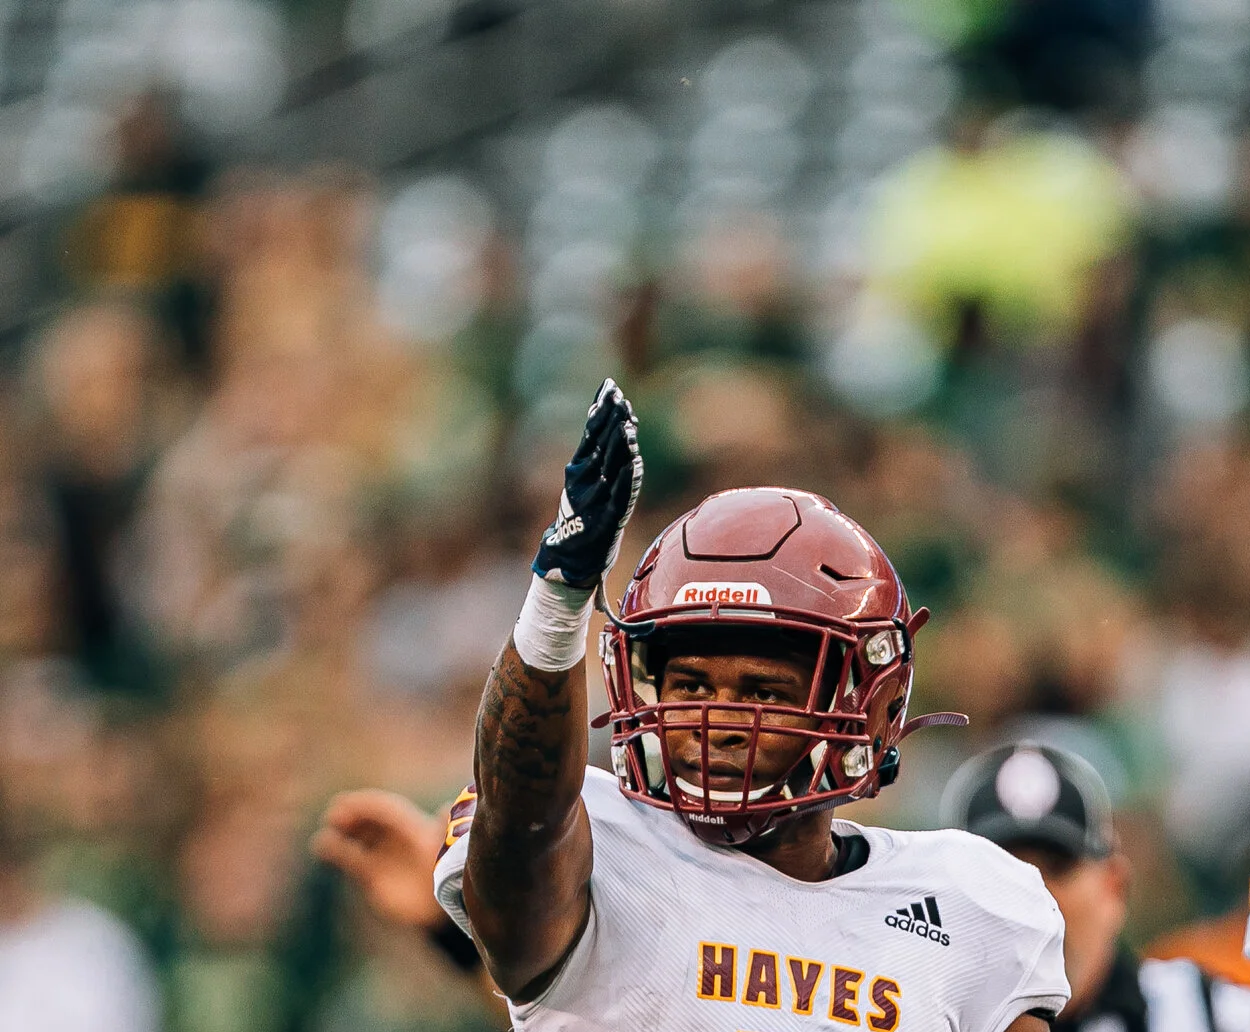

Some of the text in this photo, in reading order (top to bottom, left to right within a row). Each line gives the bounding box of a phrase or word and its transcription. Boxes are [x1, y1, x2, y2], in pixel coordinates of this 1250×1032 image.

[545, 516, 585, 546] adidas
[684, 587, 759, 603] Riddell
[885, 915, 950, 946] adidas
